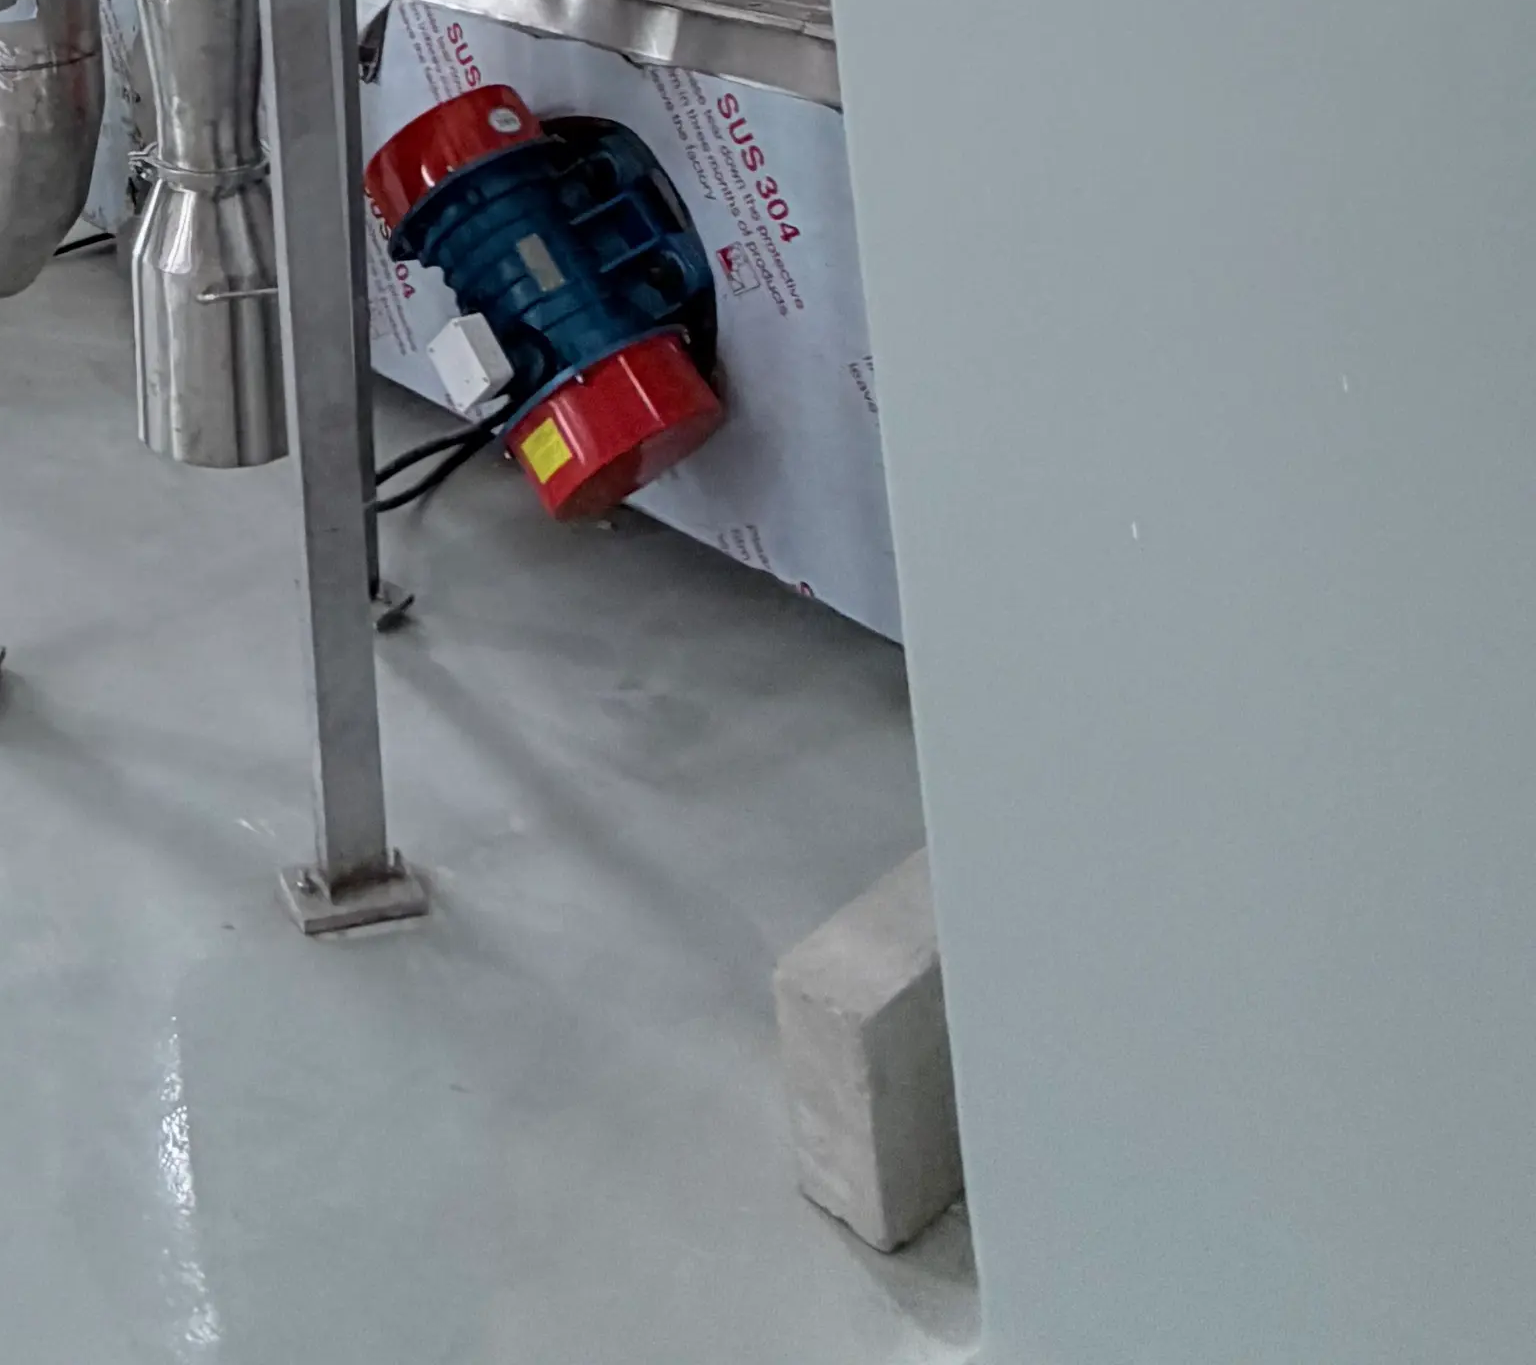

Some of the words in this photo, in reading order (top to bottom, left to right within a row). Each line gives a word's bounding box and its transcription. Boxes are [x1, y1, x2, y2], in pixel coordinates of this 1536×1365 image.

[446, 22, 482, 87] SUS
[672, 113, 688, 142] the
[685, 143, 717, 201] factory
[716, 91, 765, 173] SUS
[755, 175, 802, 244] 304
[719, 144, 747, 192] down
[743, 192, 762, 222] the
[756, 224, 805, 311] protective
[737, 219, 750, 237] of
[395, 263, 415, 299] 04
